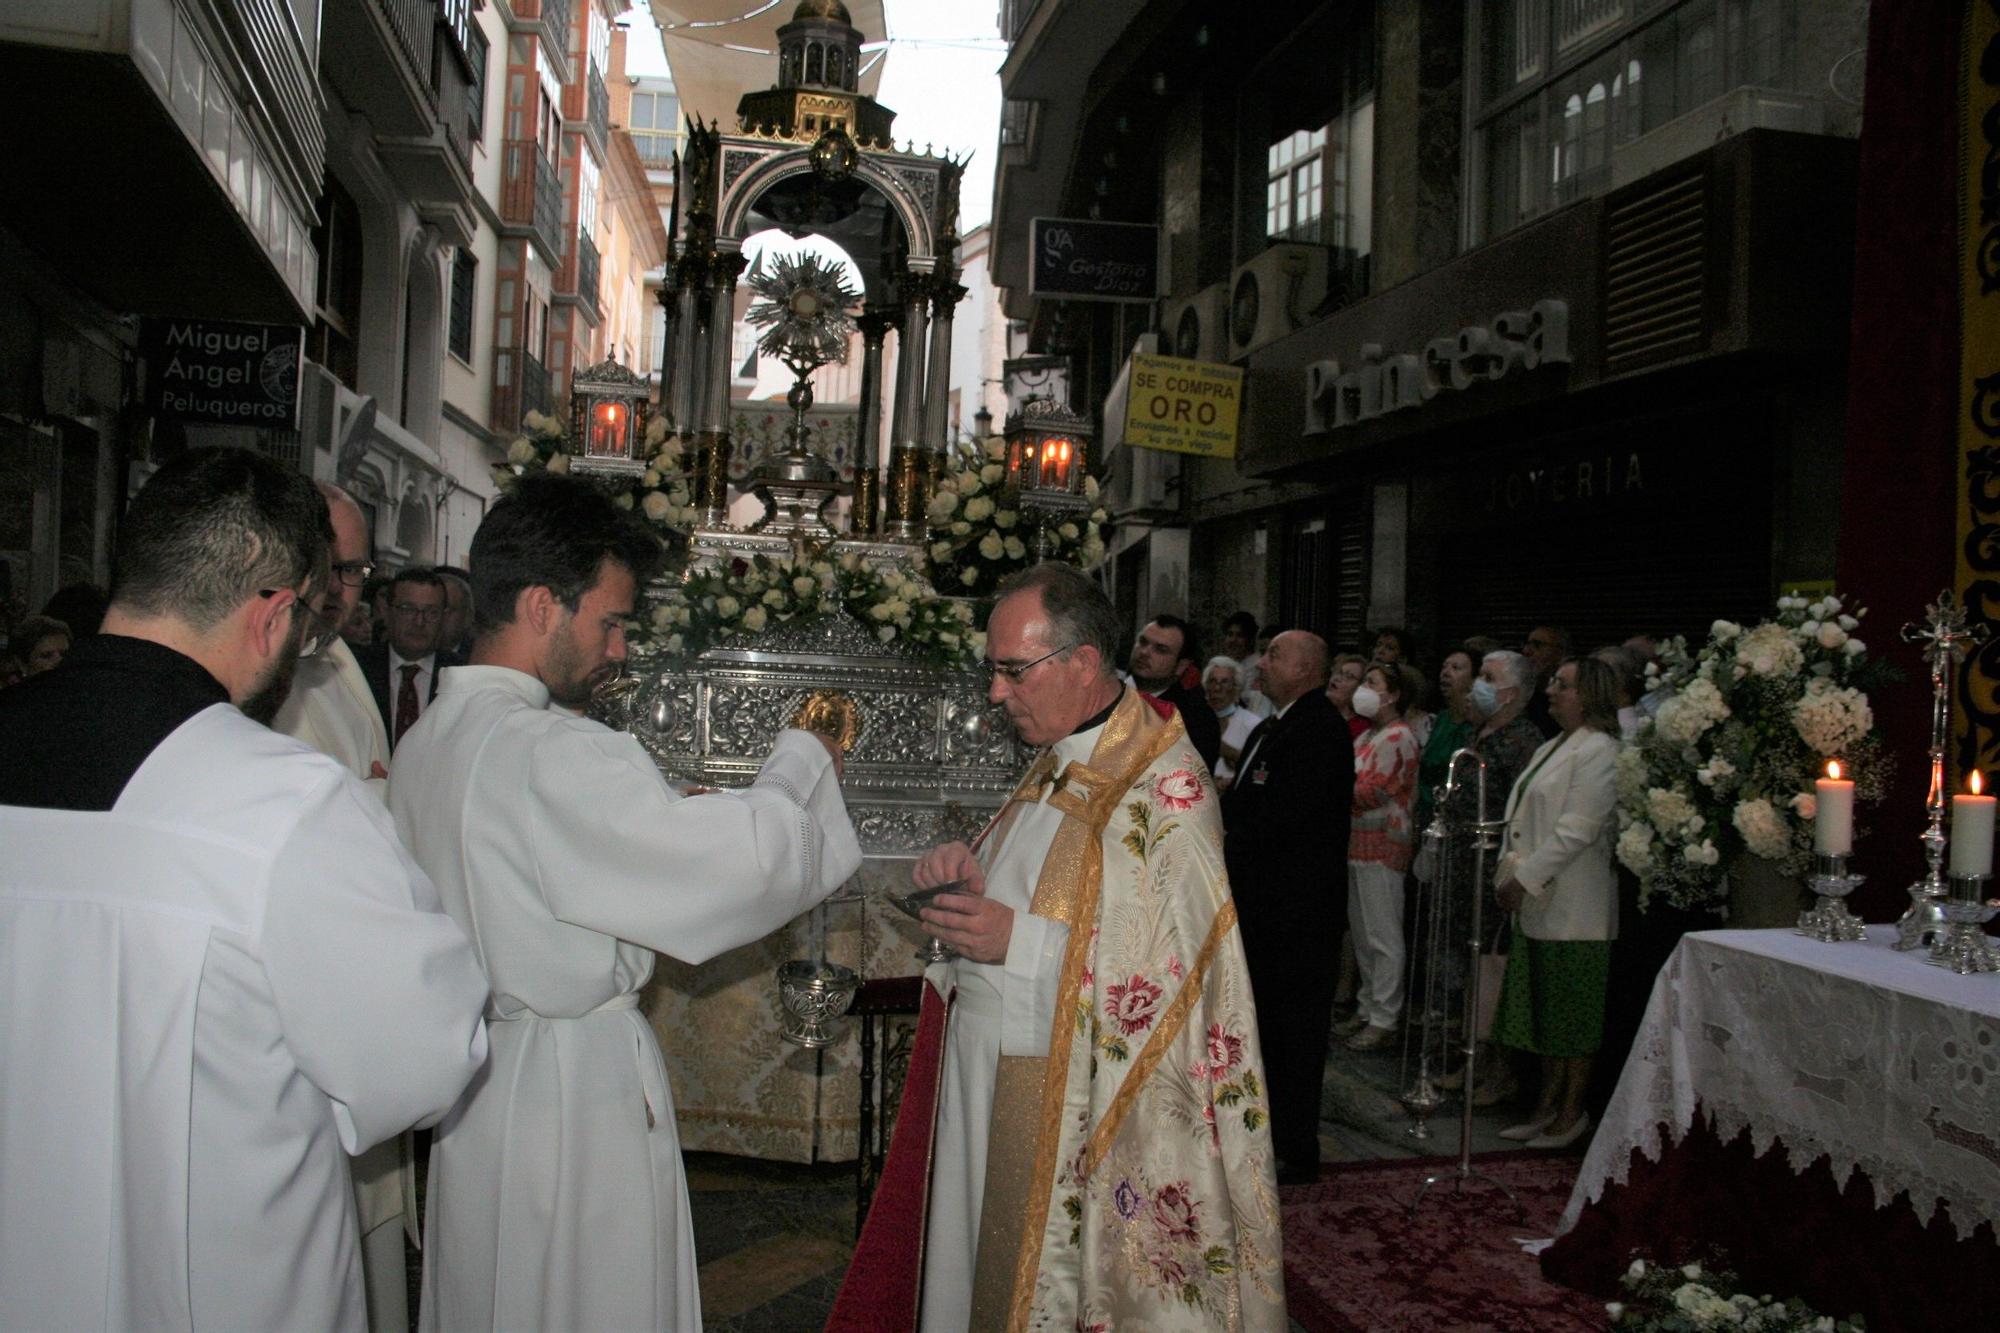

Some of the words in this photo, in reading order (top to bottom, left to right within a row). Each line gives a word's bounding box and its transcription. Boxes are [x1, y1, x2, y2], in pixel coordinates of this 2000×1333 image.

[166, 322, 269, 356] Miguel
[163, 349, 251, 388] Ángel
[1302, 299, 1572, 436] Princesa
[1136, 372, 1156, 388] SE
[1166, 377, 1235, 400] COMPRA
[162, 391, 287, 419] Peluqueros
[1150, 395, 1216, 426] ORO
